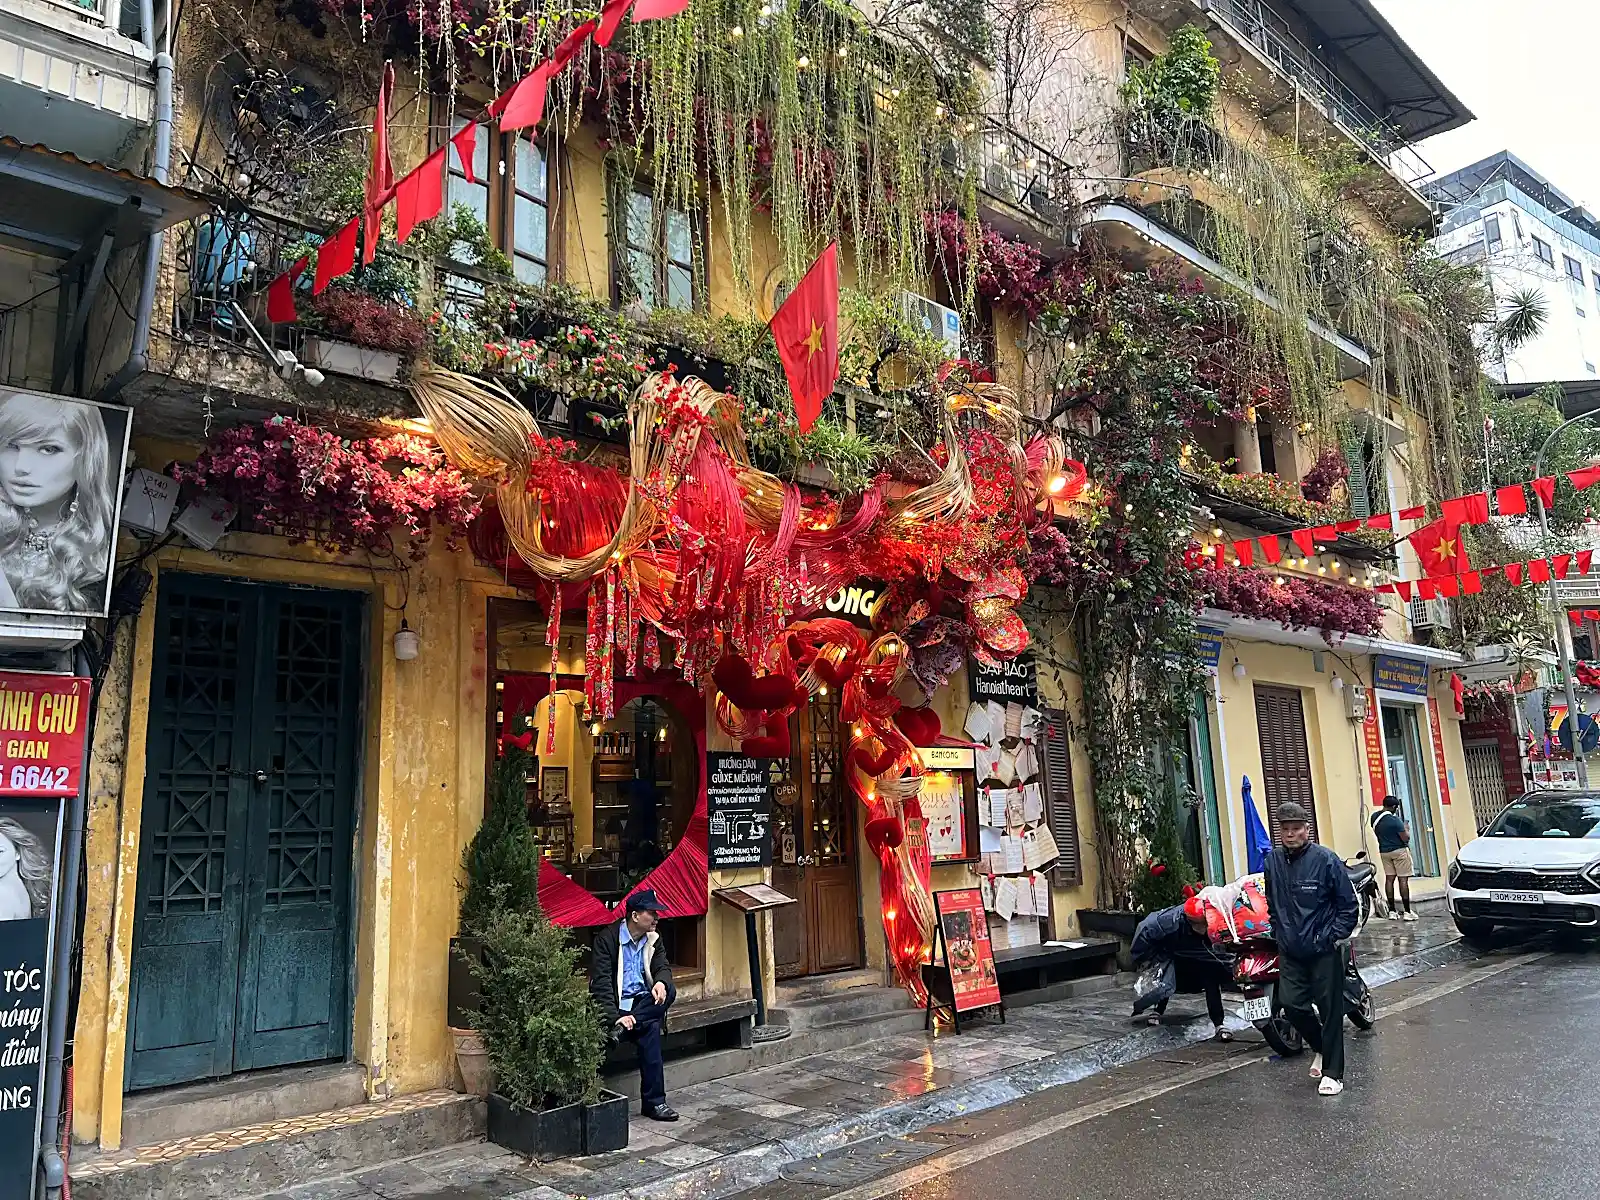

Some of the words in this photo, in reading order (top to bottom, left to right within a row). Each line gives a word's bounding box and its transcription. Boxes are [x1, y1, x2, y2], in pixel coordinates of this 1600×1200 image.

[37, 682, 79, 735] CHỦ
[6, 740, 49, 759] GIAN
[10, 765, 70, 790] 6642
[776, 784, 797, 796] OPEN
[3, 962, 41, 993] TÓC
[1, 1030, 40, 1068] điểm
[0, 1085, 32, 1111] NG
